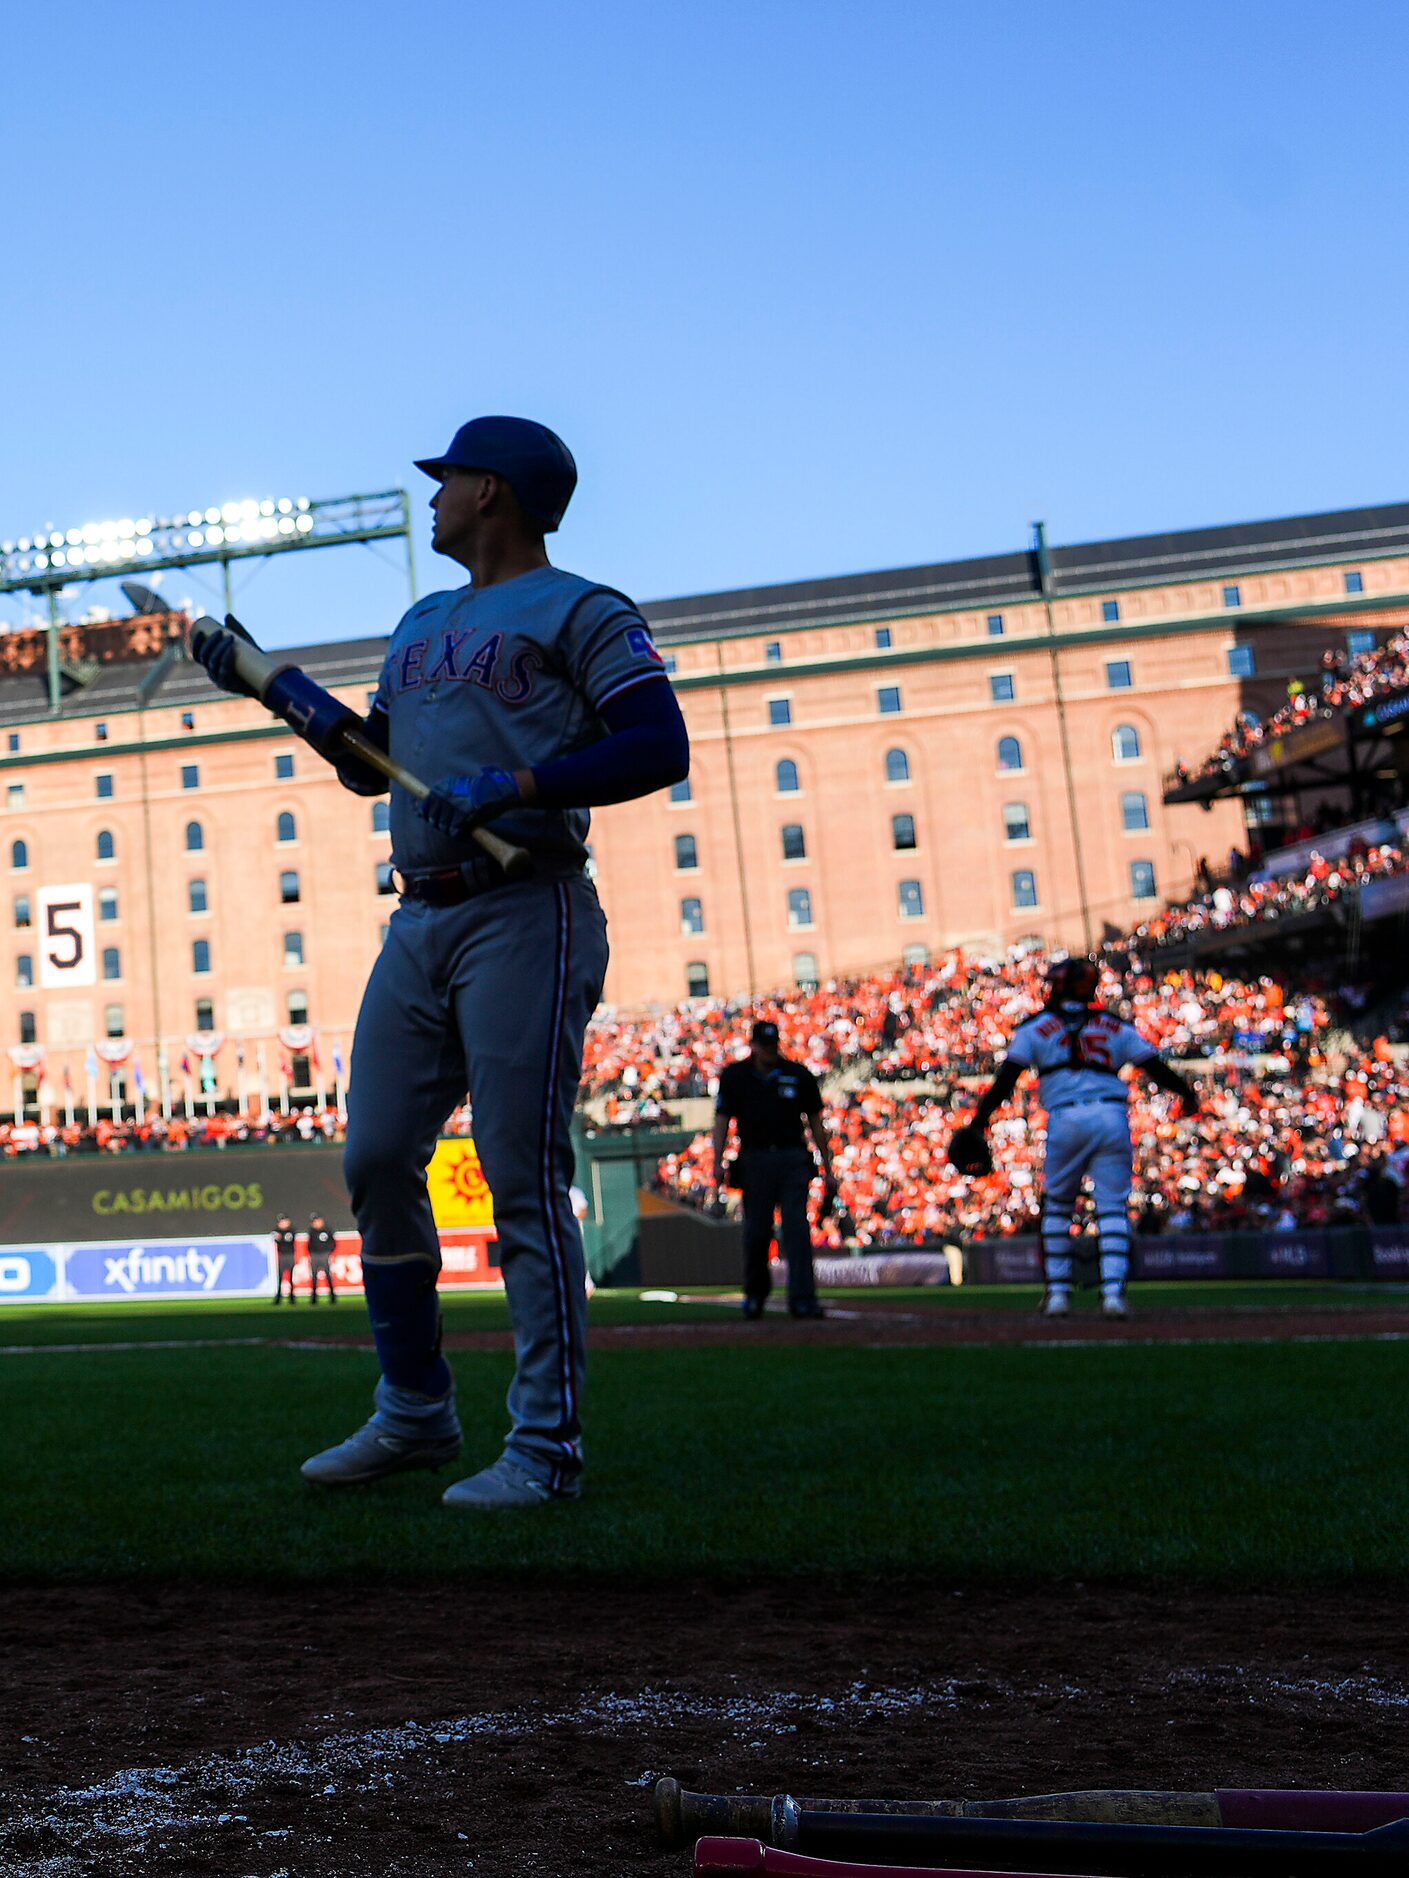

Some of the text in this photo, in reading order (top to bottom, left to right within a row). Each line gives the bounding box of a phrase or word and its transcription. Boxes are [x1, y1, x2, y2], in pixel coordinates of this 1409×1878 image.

[386, 627, 543, 705] TEXAS
[47, 901, 83, 969] 5
[91, 1183, 263, 1216] CASAMIGOS
[103, 1247, 228, 1293] xfinity
